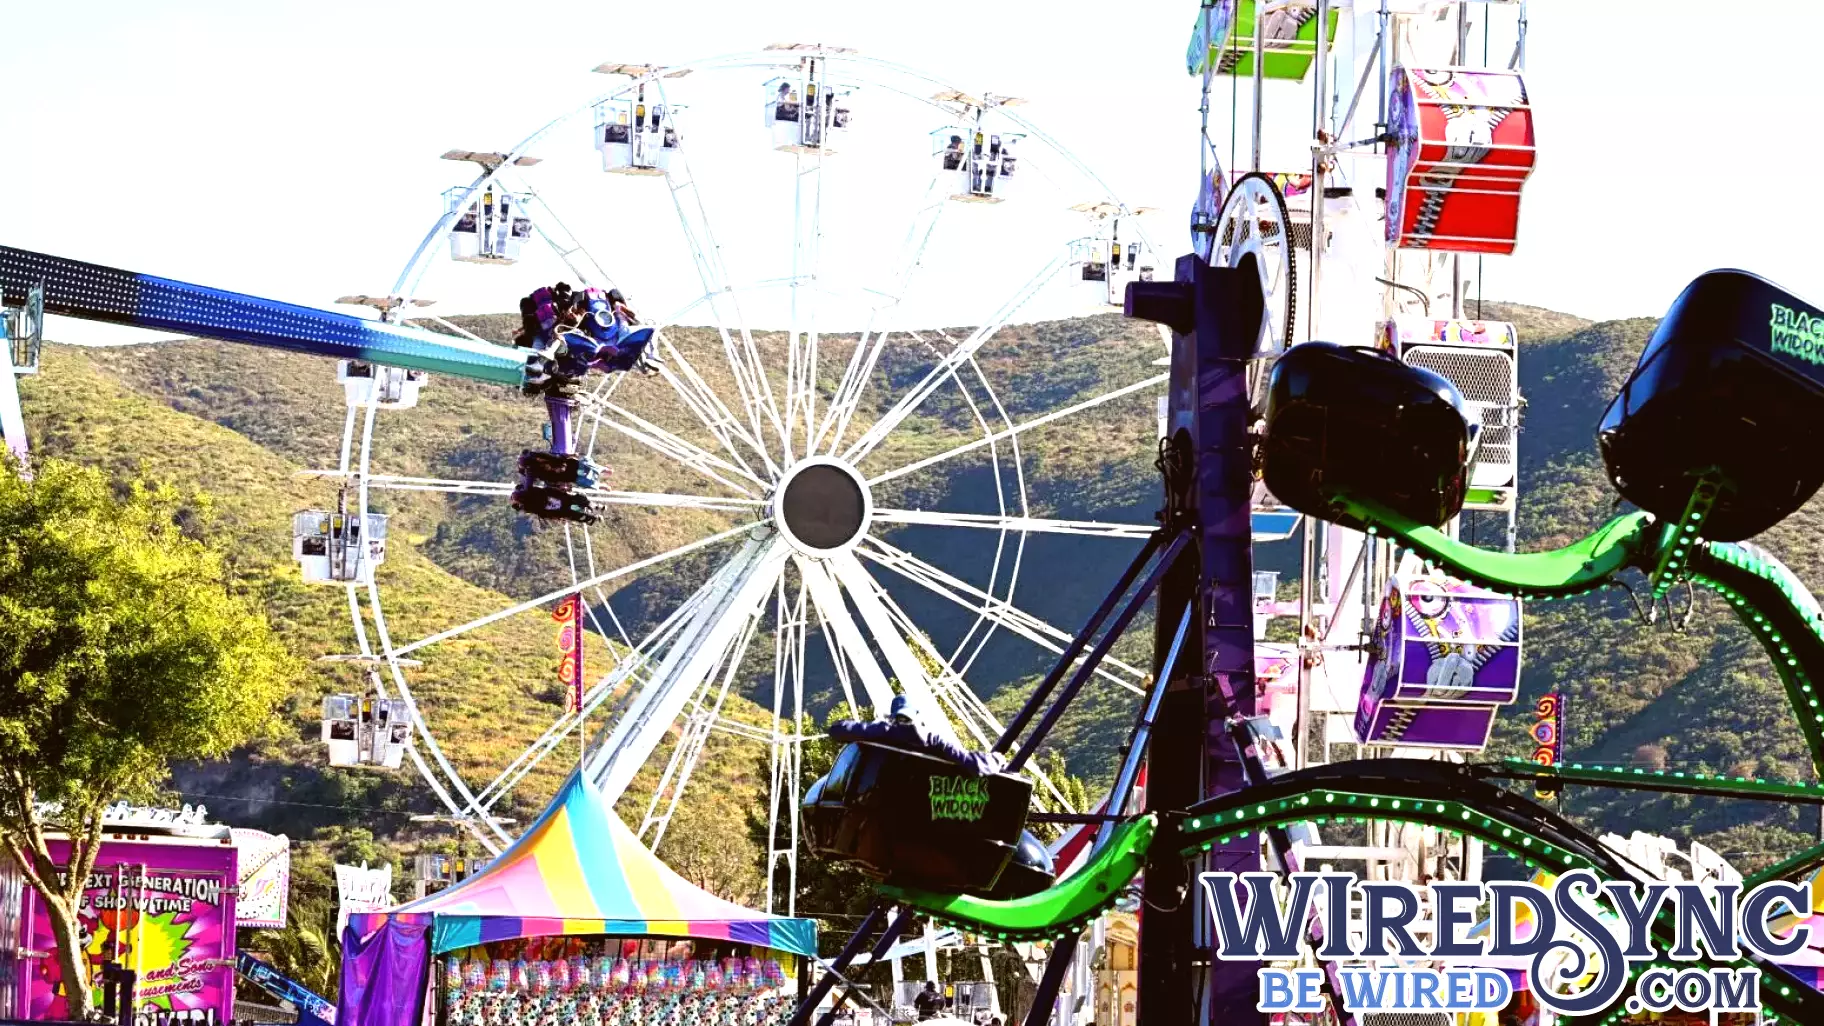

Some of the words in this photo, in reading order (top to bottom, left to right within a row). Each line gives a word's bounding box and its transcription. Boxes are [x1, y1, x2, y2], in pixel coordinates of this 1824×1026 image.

[1771, 303, 1824, 338] BLAC
[930, 775, 988, 797] BLACK
[932, 798, 985, 819] WIDOW
[84, 873, 112, 887] EXT
[118, 875, 219, 906] GENERATION
[146, 963, 175, 980] and
[178, 957, 213, 976] Sons
[133, 979, 203, 998] usements
